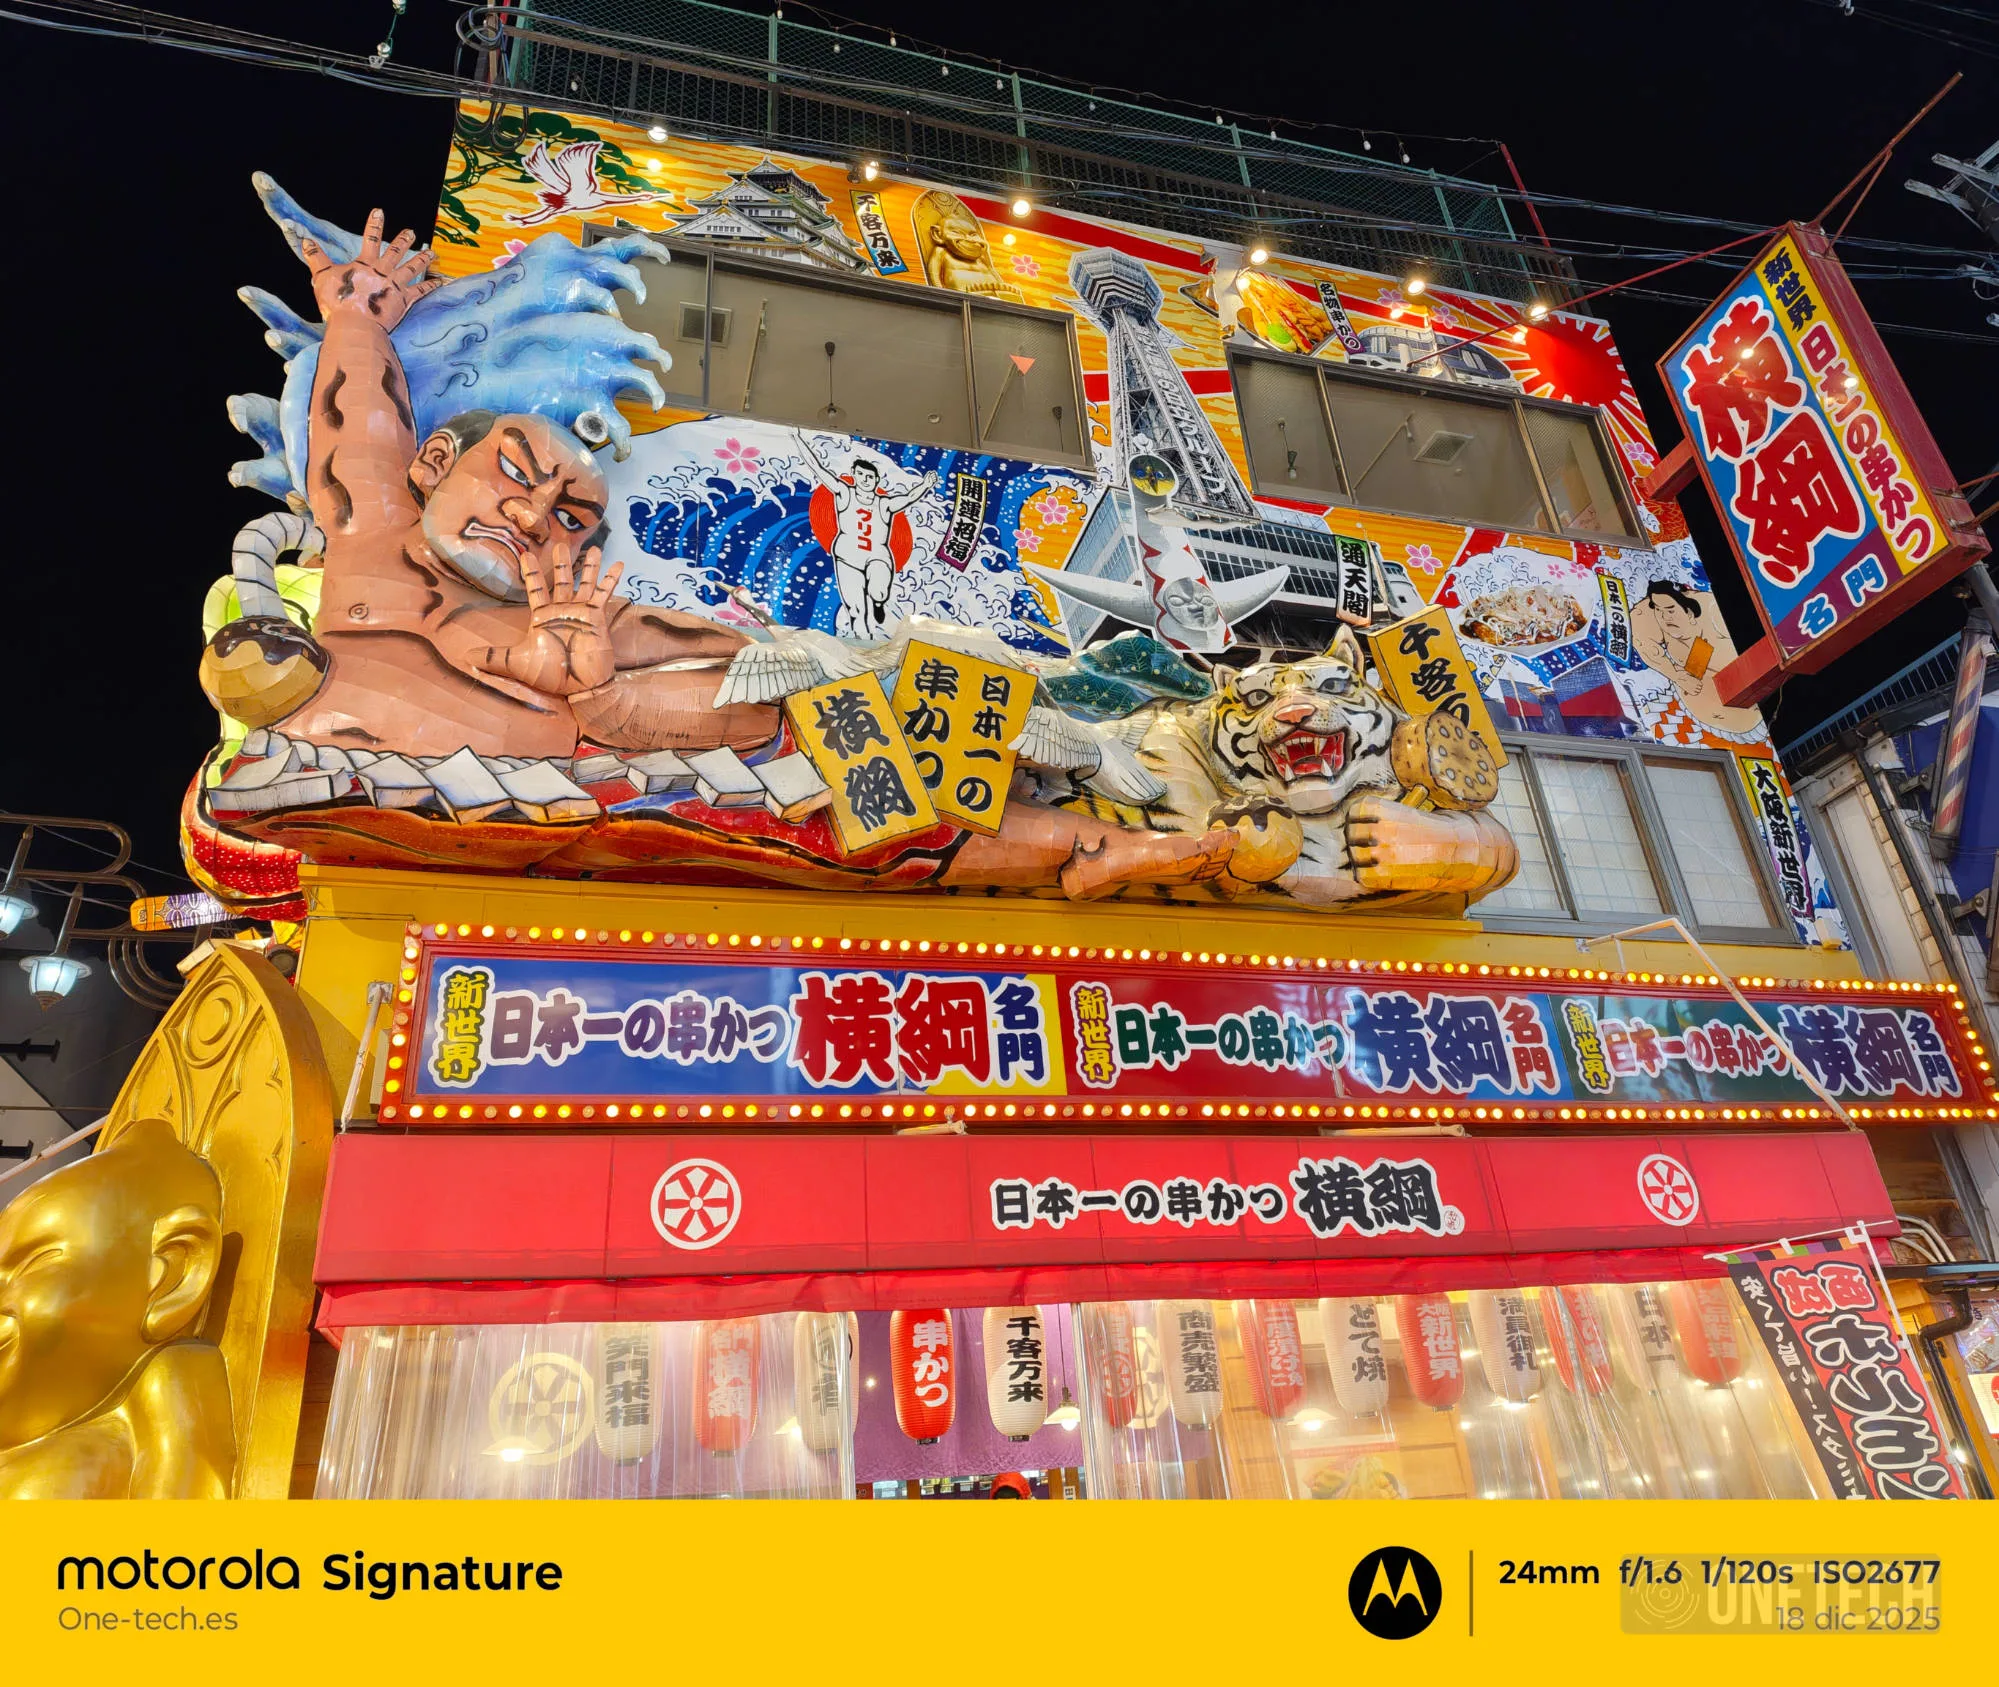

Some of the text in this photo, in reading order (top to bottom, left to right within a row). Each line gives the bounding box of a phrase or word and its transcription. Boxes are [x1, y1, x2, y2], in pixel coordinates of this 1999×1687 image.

[856, 194, 900, 268] 千客万来
[1682, 296, 1866, 589] 横綱
[1763, 246, 1935, 563] 新世界 日本一の串かつ
[856, 507, 873, 552] グリコ
[945, 477, 982, 561] 開運招福
[1340, 540, 1369, 618] 通天閣
[1606, 580, 1628, 661] 日本一の横綱
[1800, 554, 1887, 639] 名門
[1399, 622, 1482, 740] 千客万
[811, 688, 918, 833] 横綱
[903, 657, 1012, 813] 日本一の 串かつ
[1752, 762, 1807, 911] 大阪新世界
[435, 970, 1045, 1084] 新世界 日本一の串かつ 横綱 名門
[1074, 985, 1557, 1092] 新世界 日本一の串かつ 横綱 名門
[1566, 1001, 1960, 1095] 新世界 日本一の串かつ 横綱 名門
[994, 1160, 1443, 1235] 日本一の串かつ 横綱
[604, 1334, 651, 1429] 笑門来福
[912, 1319, 949, 1408] 串かつ
[1006, 1315, 1044, 1403] 千客万来
[1176, 1309, 1220, 1394] 商売繁盛
[1348, 1303, 1387, 1384] どて焼
